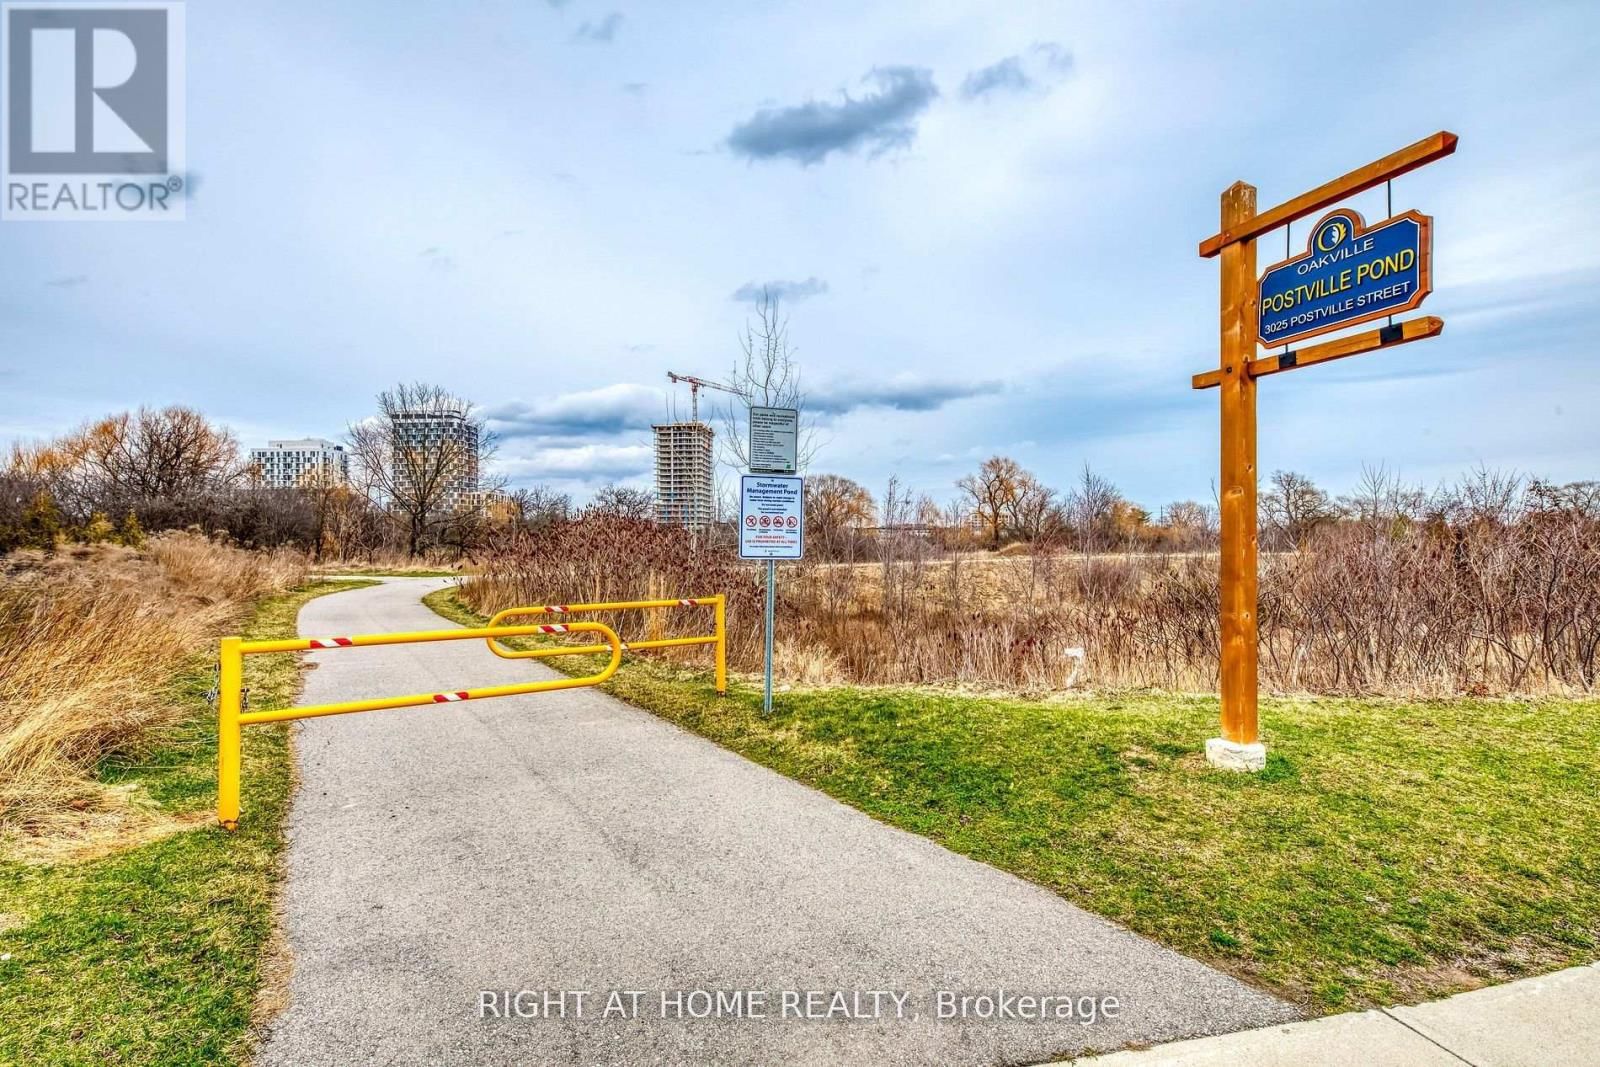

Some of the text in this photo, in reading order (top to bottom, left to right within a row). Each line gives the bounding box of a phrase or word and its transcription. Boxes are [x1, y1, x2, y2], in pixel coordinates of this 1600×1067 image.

[1262, 248, 1415, 315] POSTVILLE POND
[1297, 237, 1375, 275] OAKVILLE
[1264, 280, 1411, 335] 3025 POSTVILLE STREET
